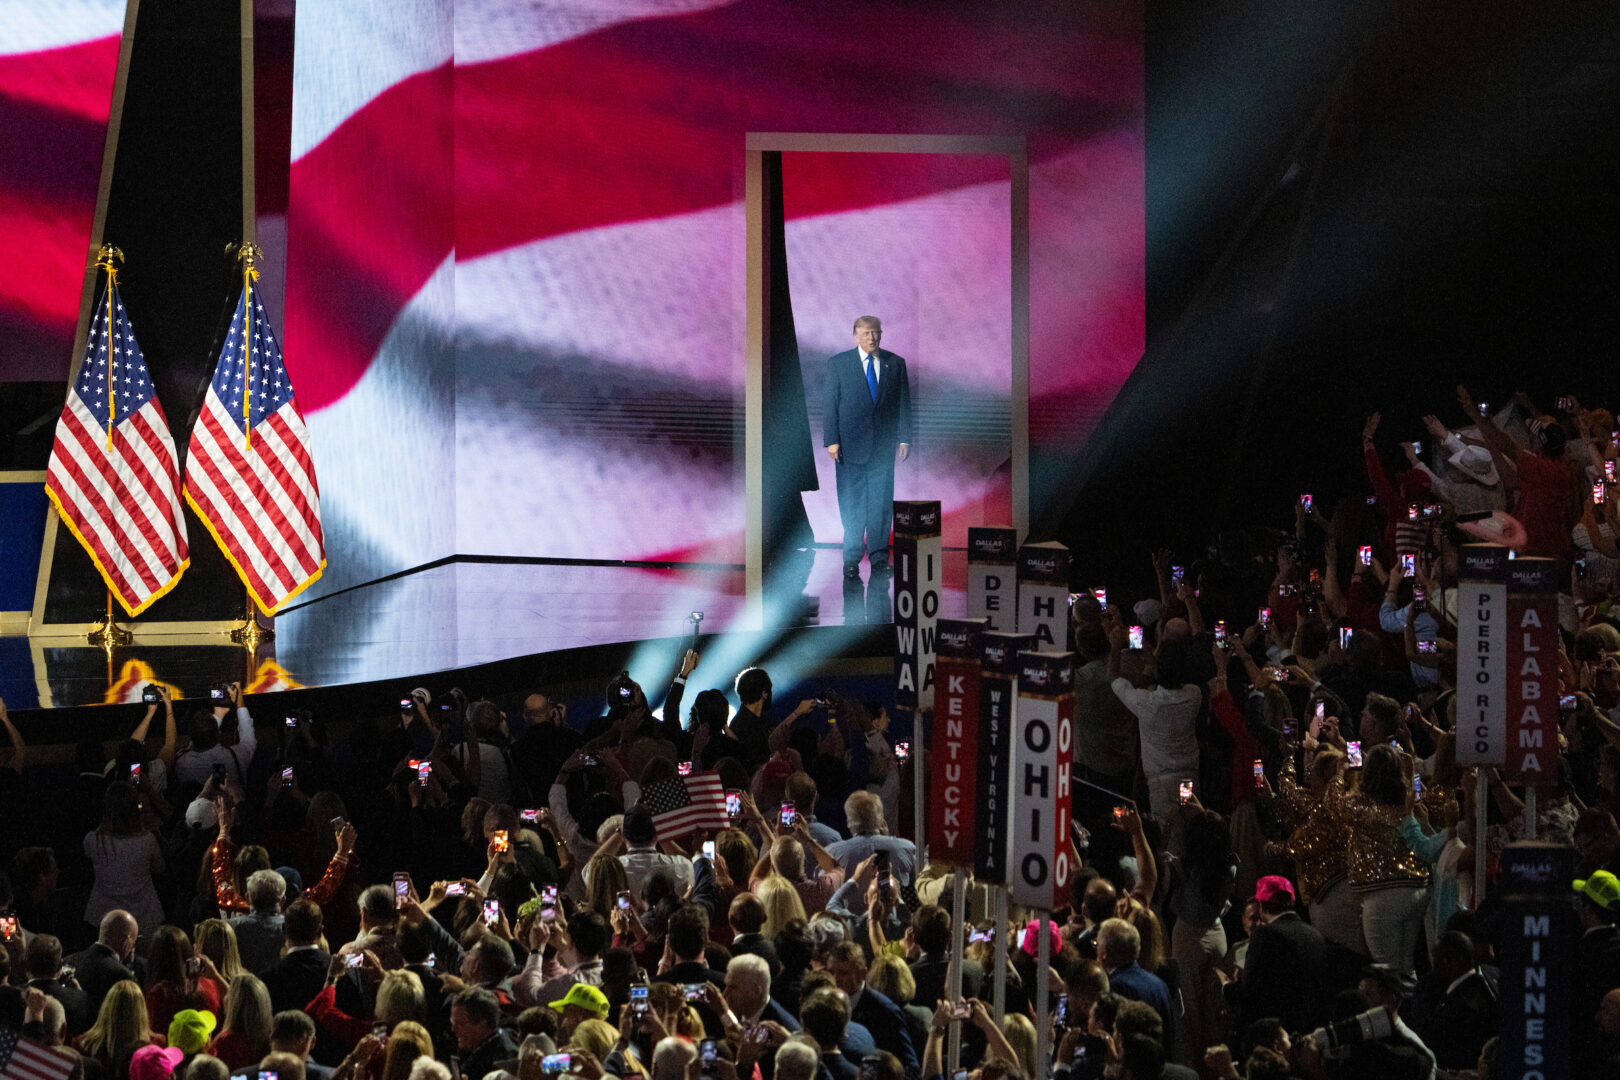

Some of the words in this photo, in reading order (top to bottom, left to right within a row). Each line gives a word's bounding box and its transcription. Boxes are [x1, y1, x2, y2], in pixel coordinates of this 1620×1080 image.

[976, 539, 1003, 547] DALLAS
[1027, 559, 1055, 567] DALLAS
[1466, 557, 1495, 565] DALLAS
[1512, 571, 1541, 579] DALLAS
[896, 554, 915, 692] IOWA
[922, 554, 939, 691] IOWA
[940, 632, 967, 642] DALLAS
[1476, 593, 1491, 684] PUERTO
[1023, 668, 1048, 677] DALLAS
[1519, 608, 1543, 772] ALABAMA
[990, 690, 1001, 745] WEST
[1475, 695, 1489, 754] RICO
[944, 675, 964, 848] KENTUCKY
[986, 756, 997, 868] VIRGINIA
[1021, 718, 1051, 887] OHIO
[1056, 718, 1071, 887] OHIO
[1511, 863, 1552, 873] DALLAS
